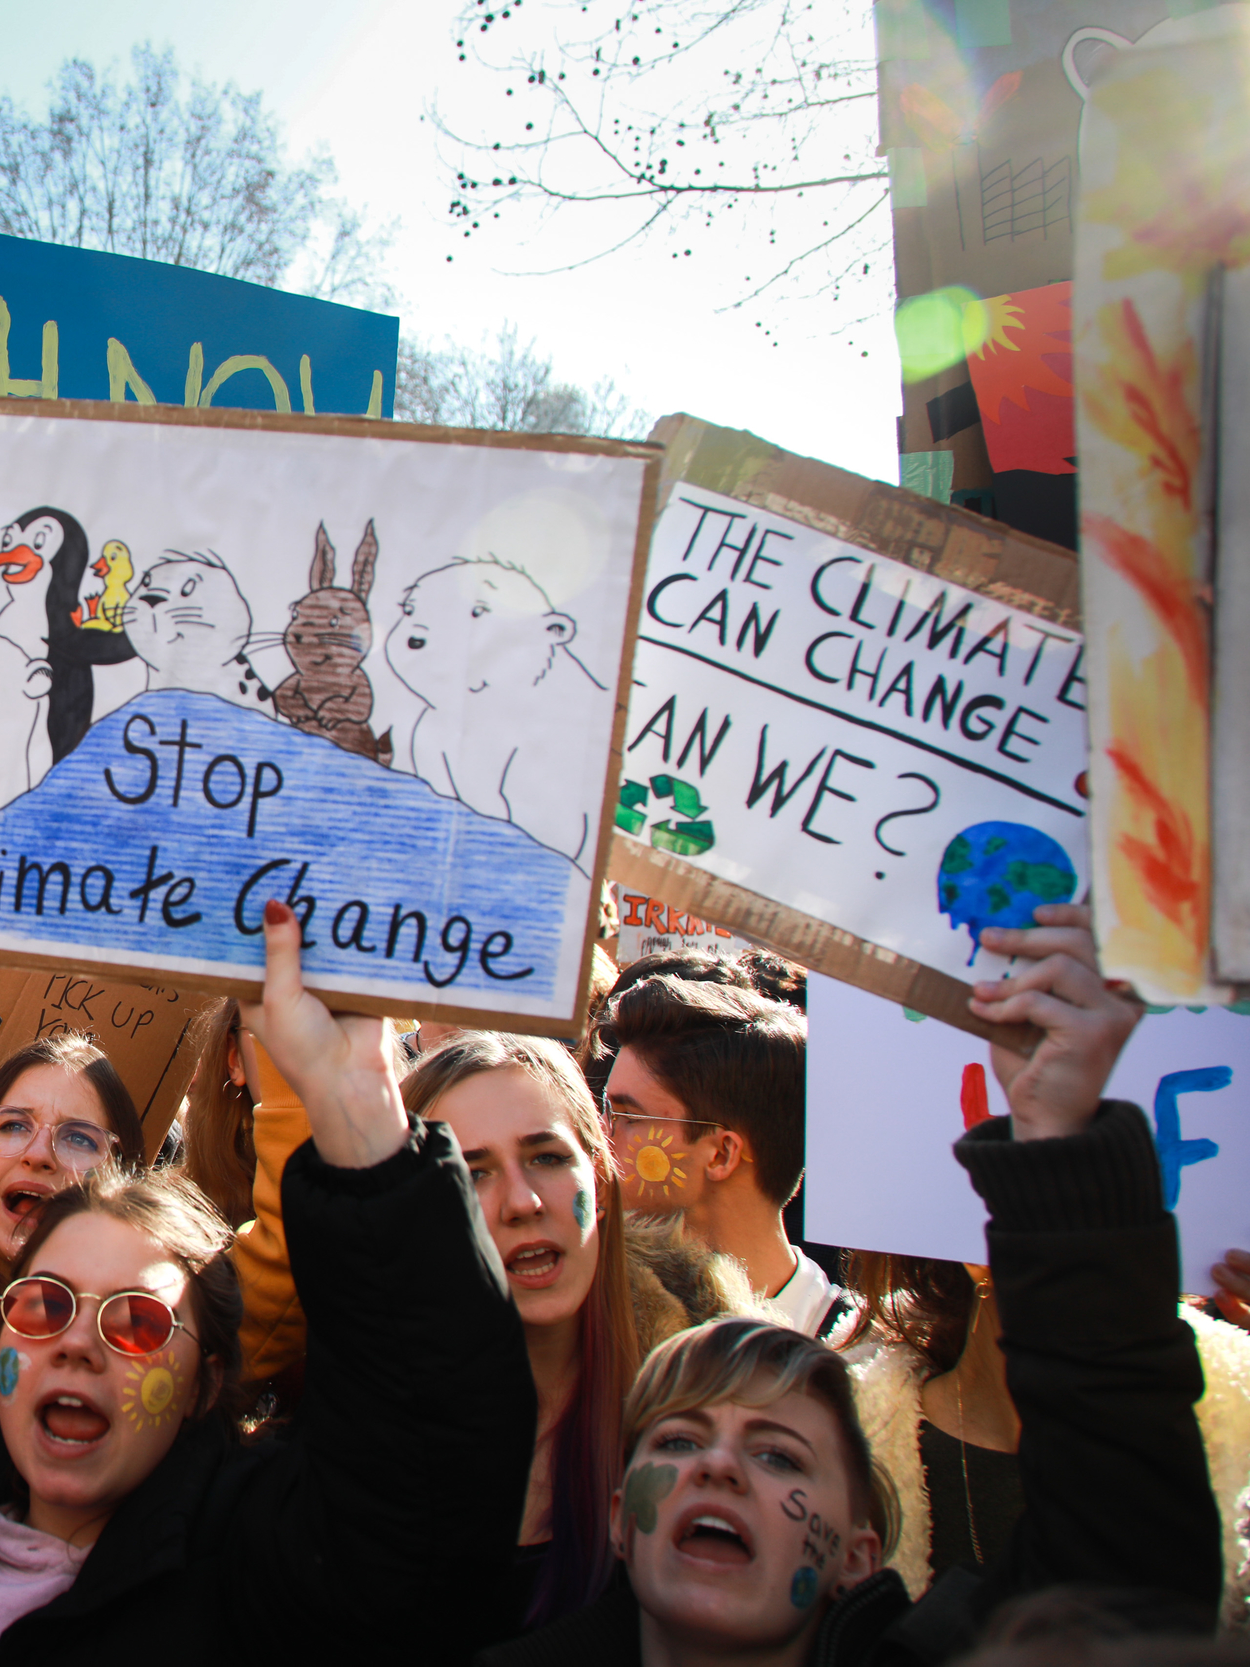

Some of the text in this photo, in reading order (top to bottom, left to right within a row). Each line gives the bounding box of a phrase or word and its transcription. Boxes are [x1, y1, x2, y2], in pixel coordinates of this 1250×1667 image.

[646, 572, 1051, 764] CAN CHANGE
[678, 496, 1086, 712] THE CLIMATE
[104, 714, 284, 839] Stop
[627, 680, 942, 880] AN WE?
[233, 859, 535, 988] Change
[111, 1001, 155, 1039] UP
